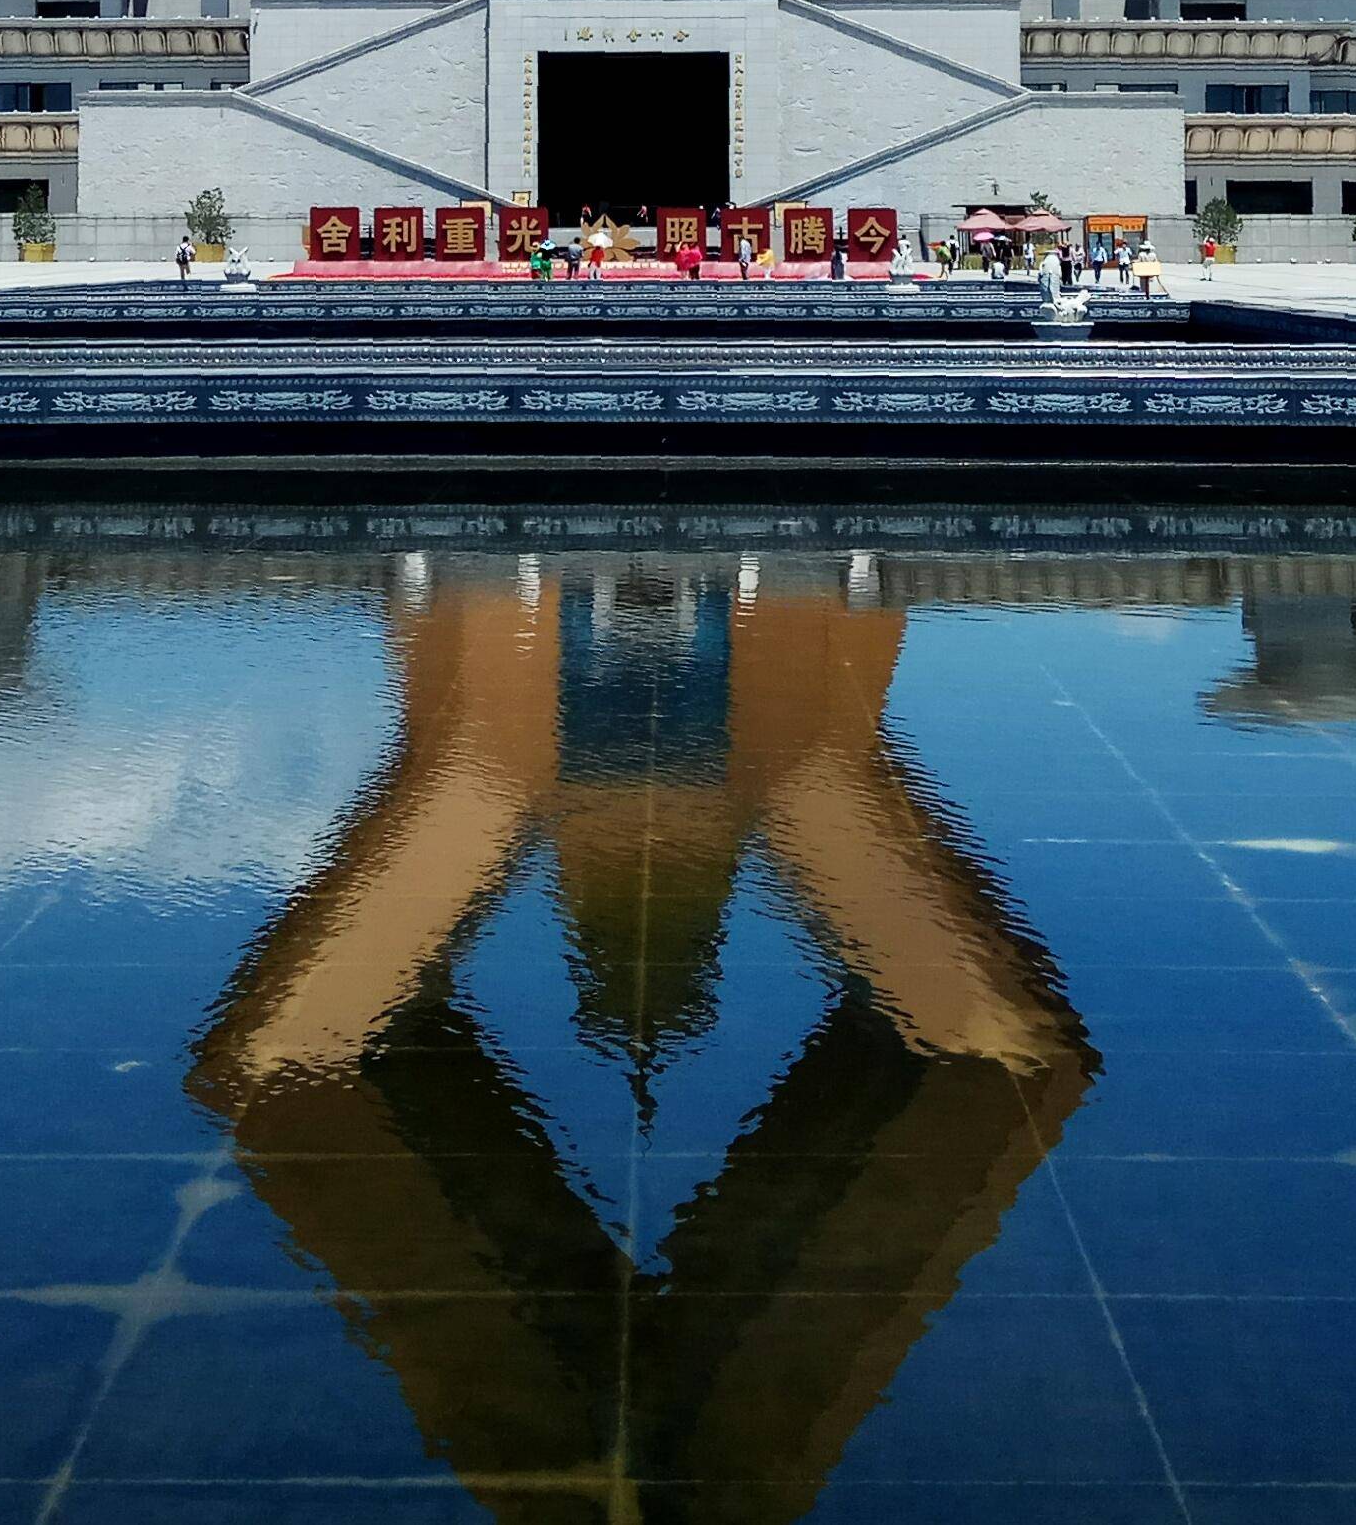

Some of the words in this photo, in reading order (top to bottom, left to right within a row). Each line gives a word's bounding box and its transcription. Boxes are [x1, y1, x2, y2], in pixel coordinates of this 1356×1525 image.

[316, 215, 542, 254] 舍利重光
[663, 216, 891, 254] 照古腾今
